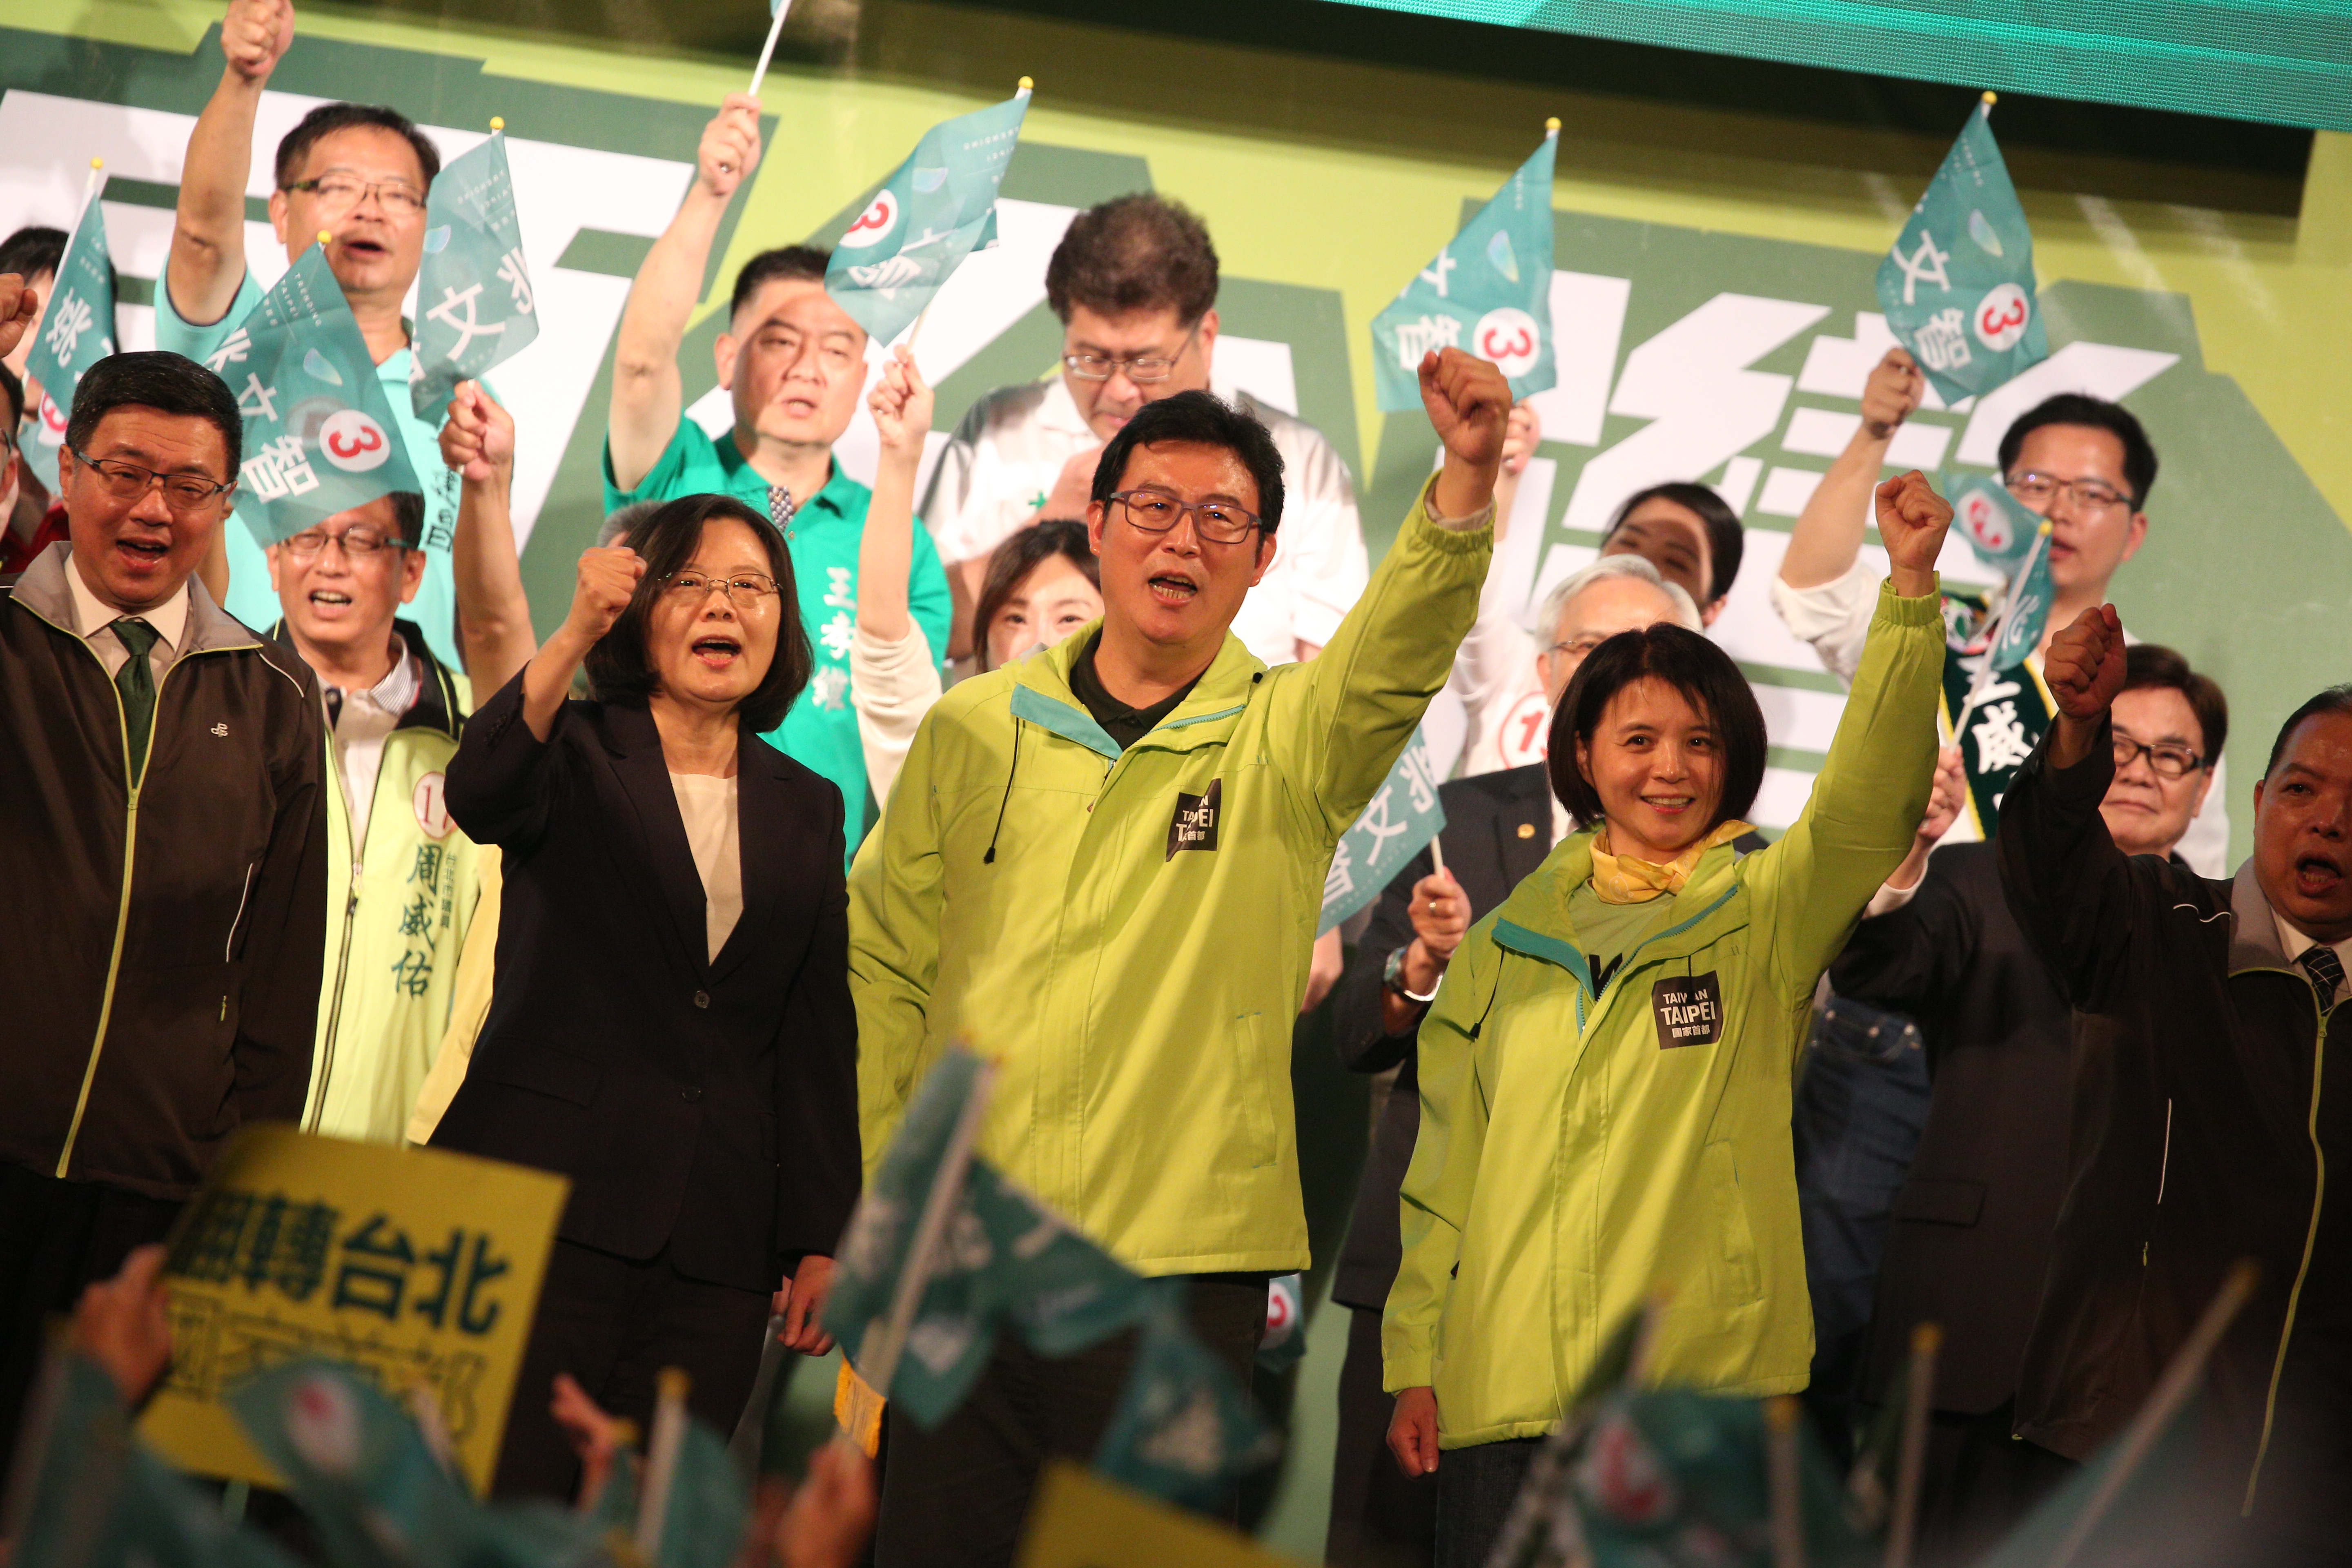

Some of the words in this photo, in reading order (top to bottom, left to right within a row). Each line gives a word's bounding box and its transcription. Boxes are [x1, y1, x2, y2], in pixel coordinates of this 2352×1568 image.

[1892, 191, 1971, 371] 文智
[1982, 298, 2025, 336] 3
[1483, 327, 1531, 359] 3
[329, 425, 382, 458] 3
[1520, 709, 1548, 758] 1
[1957, 656, 2041, 812] 王威
[391, 843, 441, 996] 周威佑
[1660, 1001, 1716, 1025] TAIPEI
[1672, 1024, 1711, 1038] 國家首都
